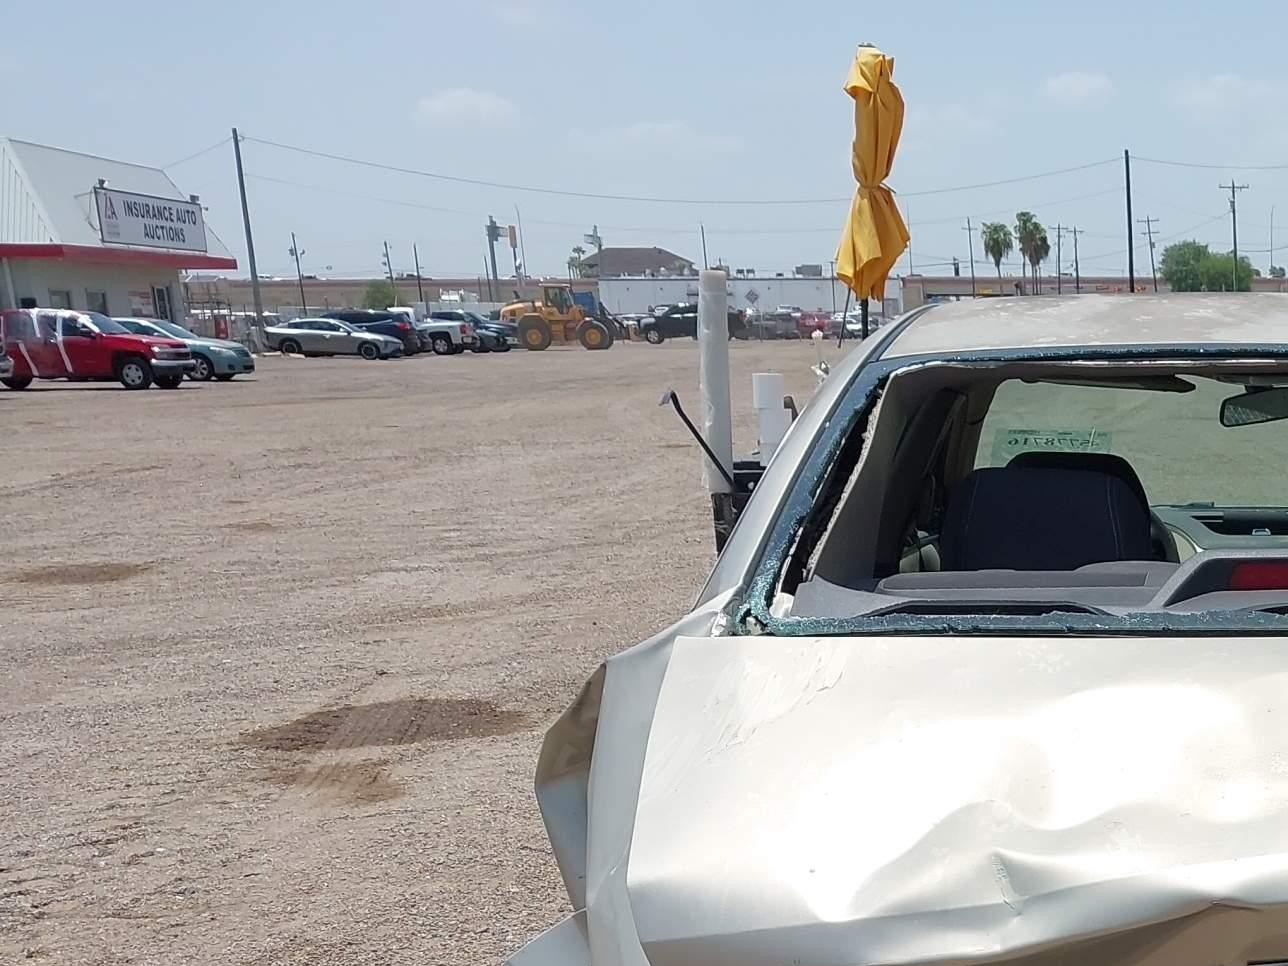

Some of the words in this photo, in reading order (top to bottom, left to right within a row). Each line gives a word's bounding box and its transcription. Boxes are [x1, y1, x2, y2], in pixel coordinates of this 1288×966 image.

[123, 199, 174, 222] INSURANCE
[176, 209, 197, 225] AUTO
[143, 222, 186, 243] AUCTIONS
